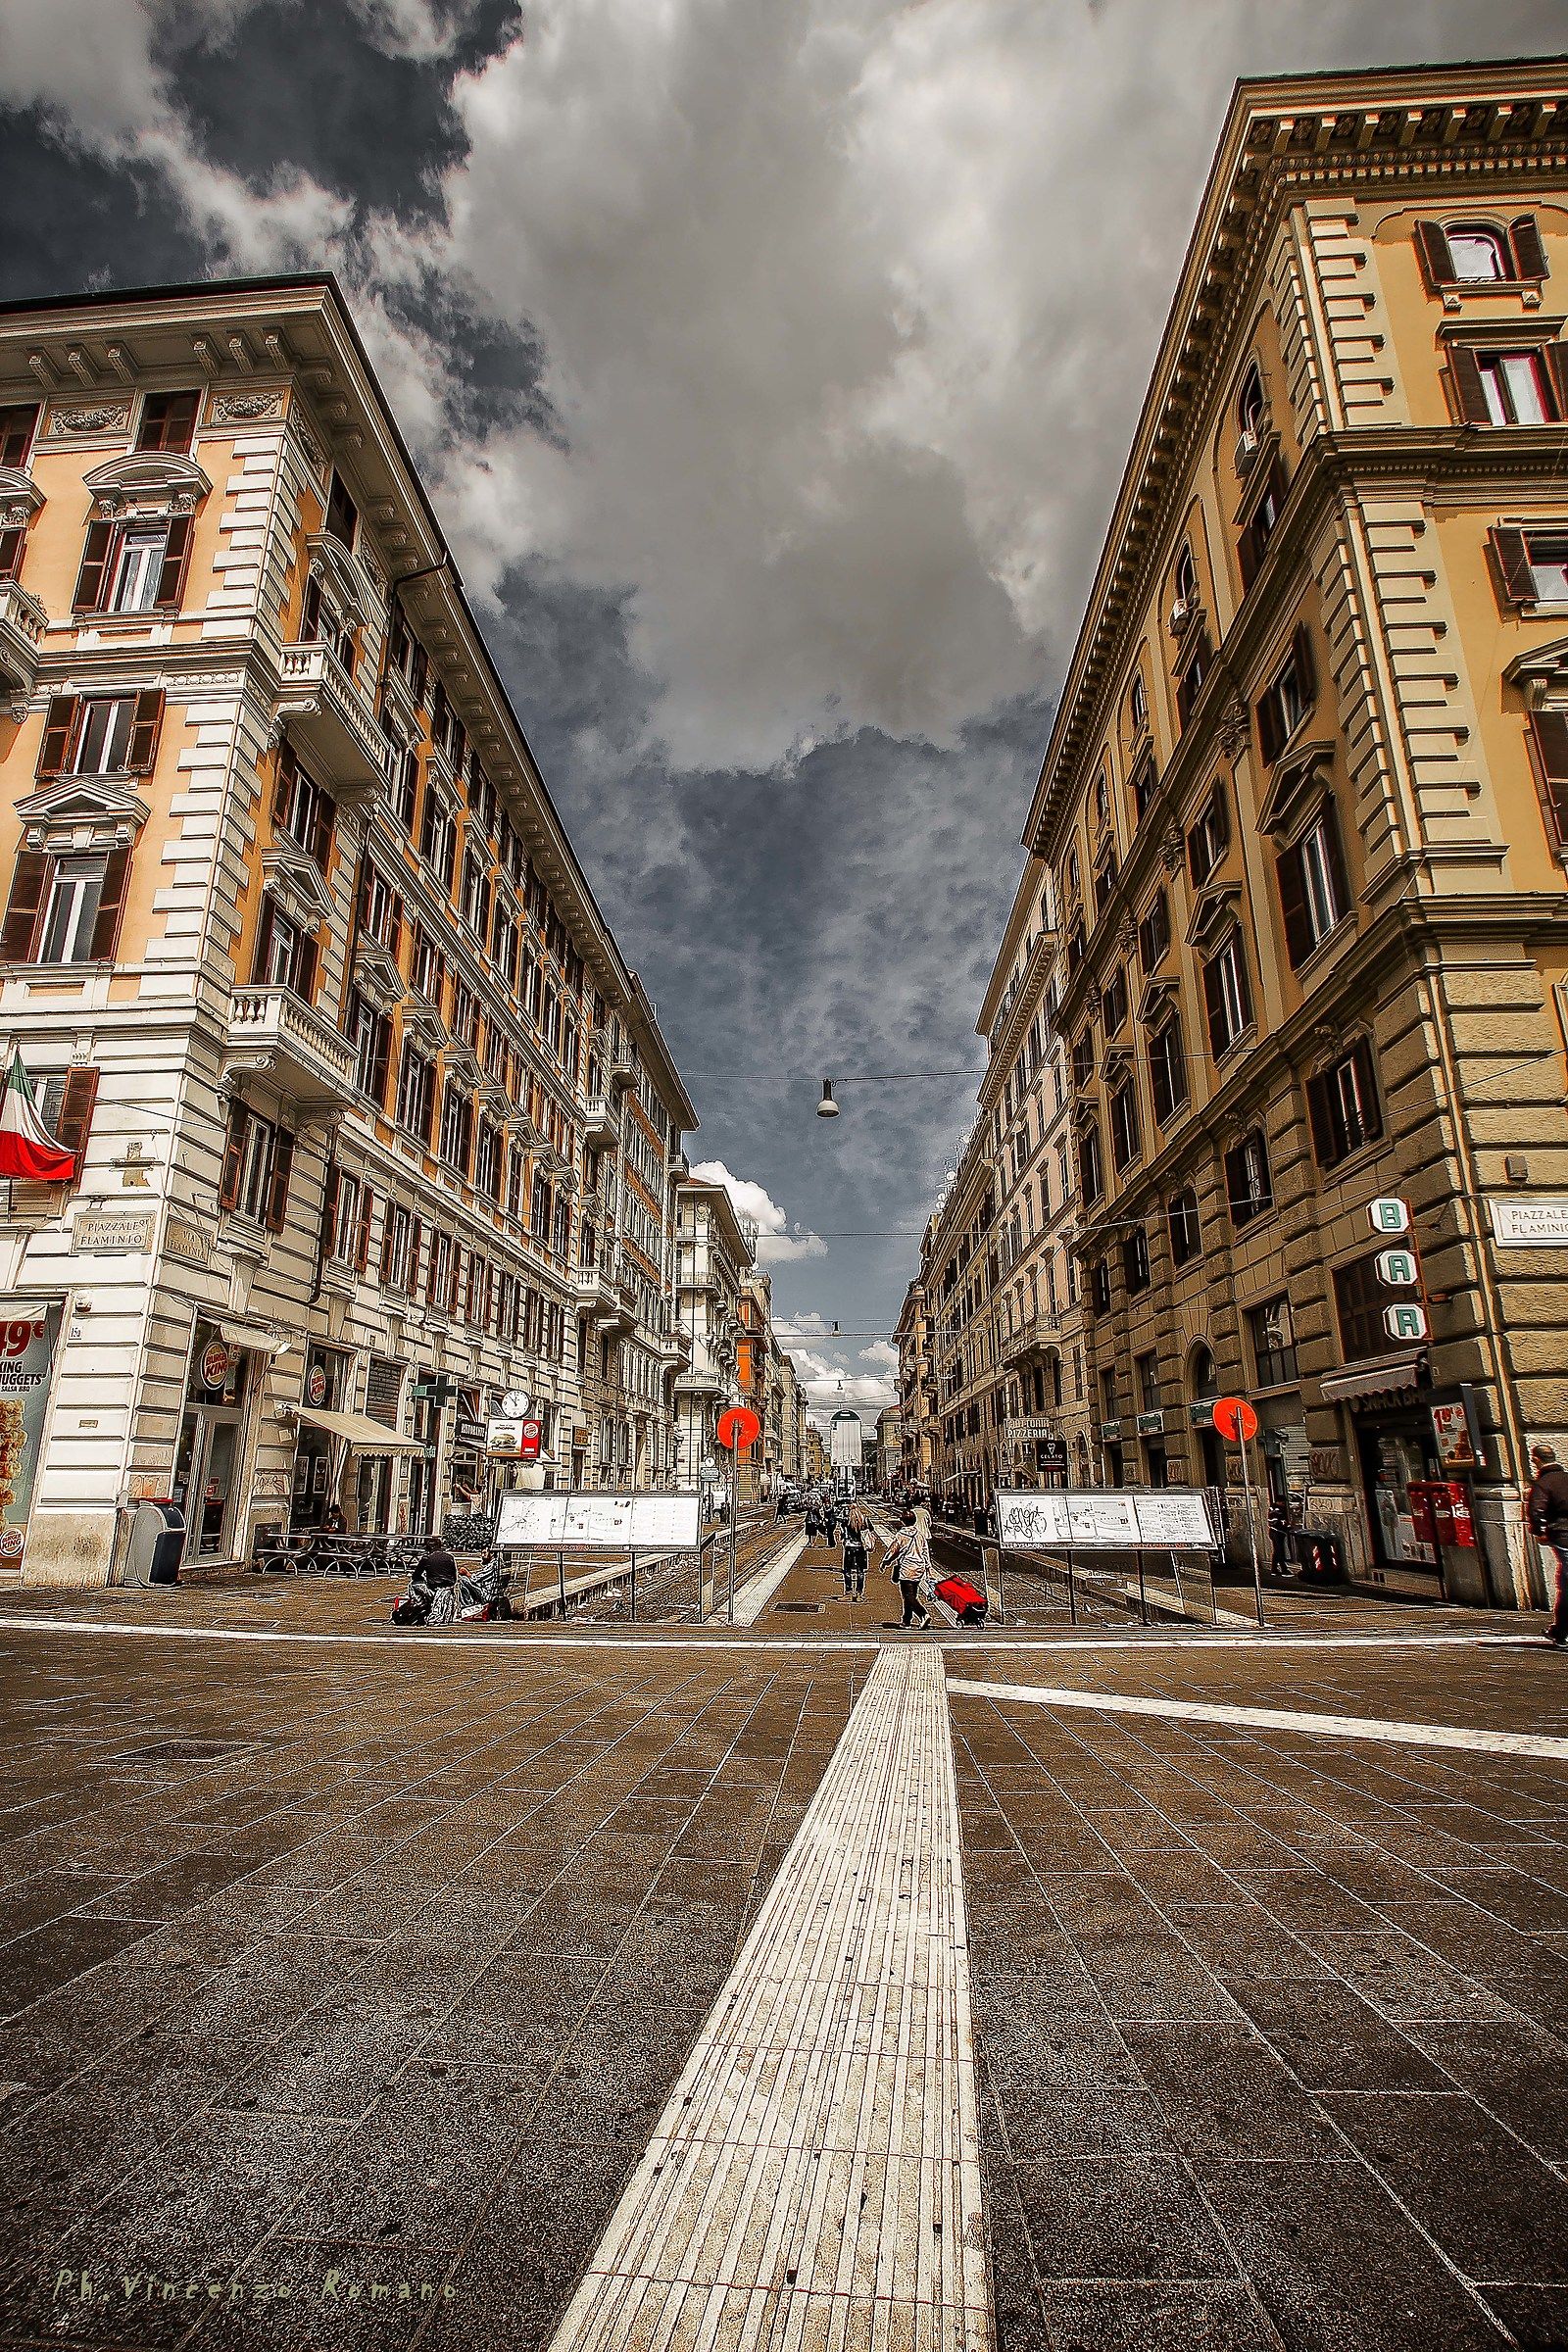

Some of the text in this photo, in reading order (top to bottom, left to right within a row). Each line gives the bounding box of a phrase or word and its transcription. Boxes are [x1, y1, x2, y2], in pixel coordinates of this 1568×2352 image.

[1511, 1209, 1568, 1220] PIAZZALE
[87, 1221, 139, 1232] PIAZZALE
[80, 1235, 142, 1246] FLAMINIO
[183, 1230, 195, 1243] VIA
[1007, 1428, 1048, 1439] PIZZERIA
